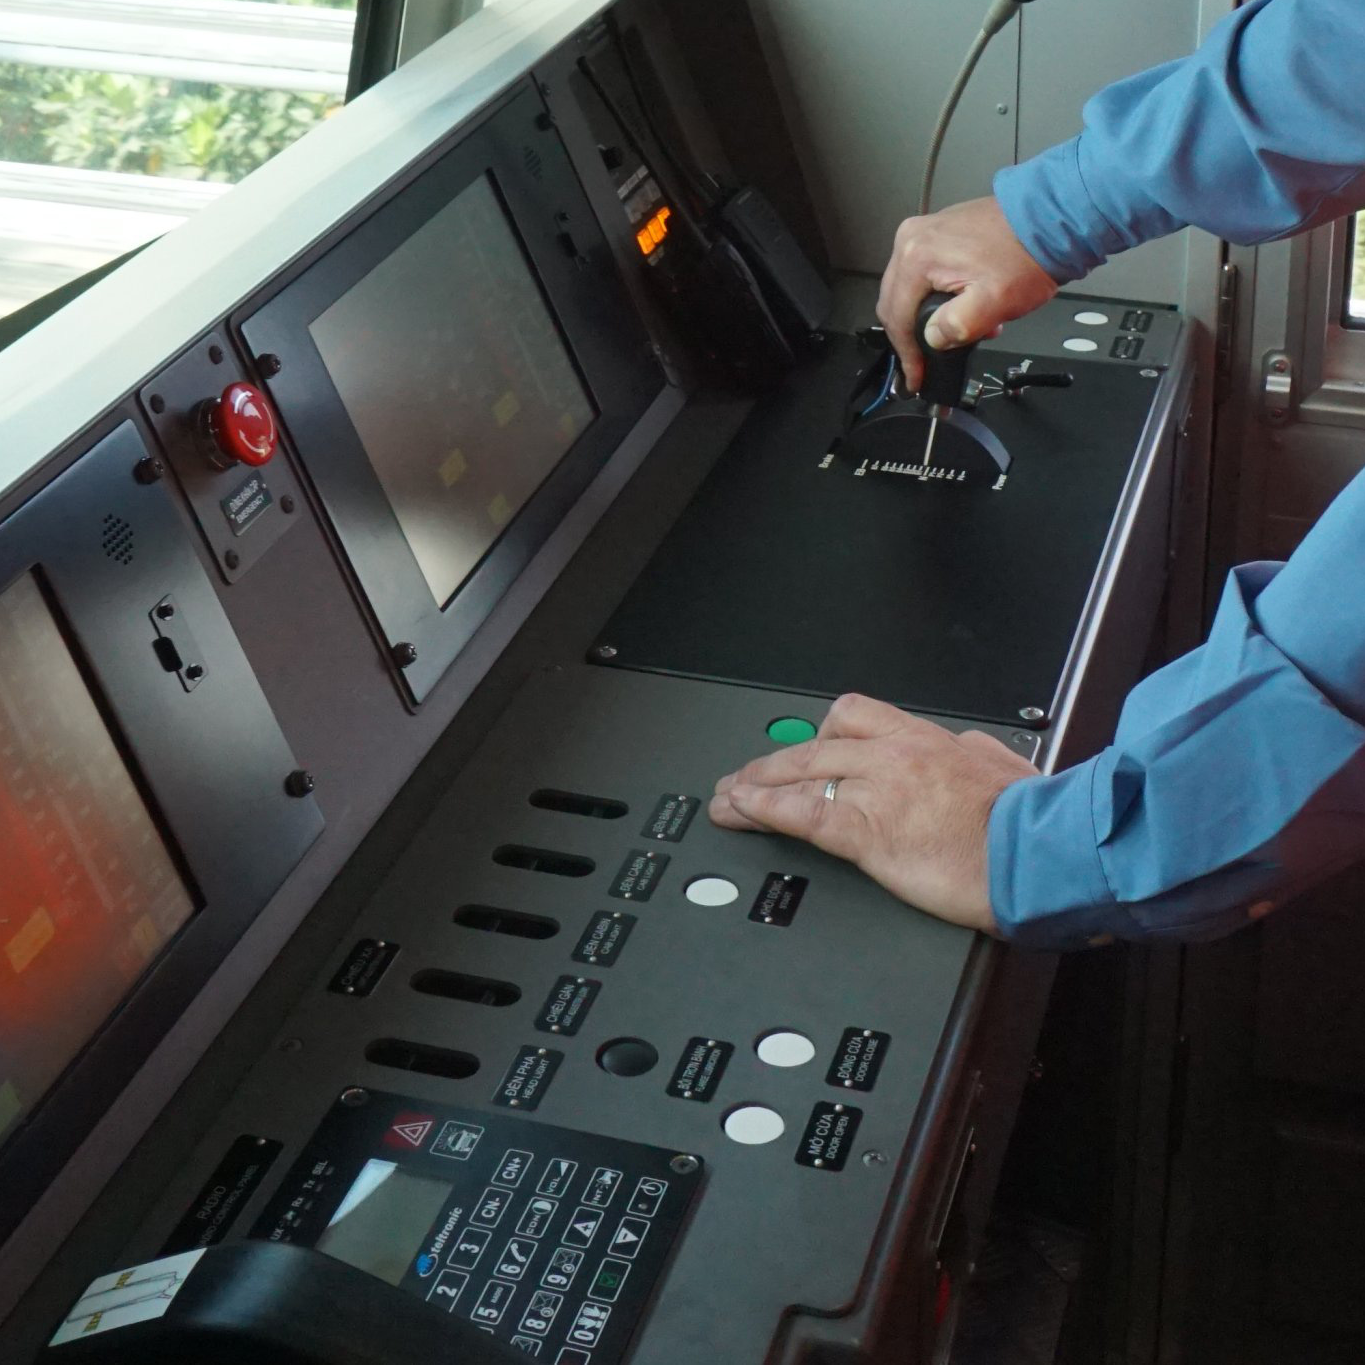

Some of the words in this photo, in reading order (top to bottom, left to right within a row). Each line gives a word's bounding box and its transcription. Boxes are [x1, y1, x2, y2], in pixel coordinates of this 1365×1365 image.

[608, 924, 621, 941] LIGHT
[854, 1061, 869, 1082] DOOR
[862, 1039, 878, 1061] CLOSE
[504, 1075, 525, 1096] ĐÈN
[516, 1056, 536, 1075] PHA
[522, 1079, 539, 1099] HEAD
[533, 1059, 549, 1079] LIGHT
[815, 1114, 834, 1136] CỬA
[808, 1136, 824, 1155] MỞ
[825, 1136, 841, 1159] DOOR
[834, 1116, 849, 1136] OPEN
[312, 1160, 328, 1176] SEL
[502, 1157, 522, 1179] CN+
[196, 1185, 226, 1220] RADIO
[481, 1197, 501, 1218] CN-
[431, 1206, 463, 1254] teltronic
[459, 1243, 480, 1254] 3
[500, 1263, 521, 1274] 6
[547, 1274, 568, 1285] 9
[436, 1285, 458, 1297] 2
[476, 1306, 498, 1319] 5
[525, 1318, 547, 1330] 8
[573, 1330, 595, 1341] 0
